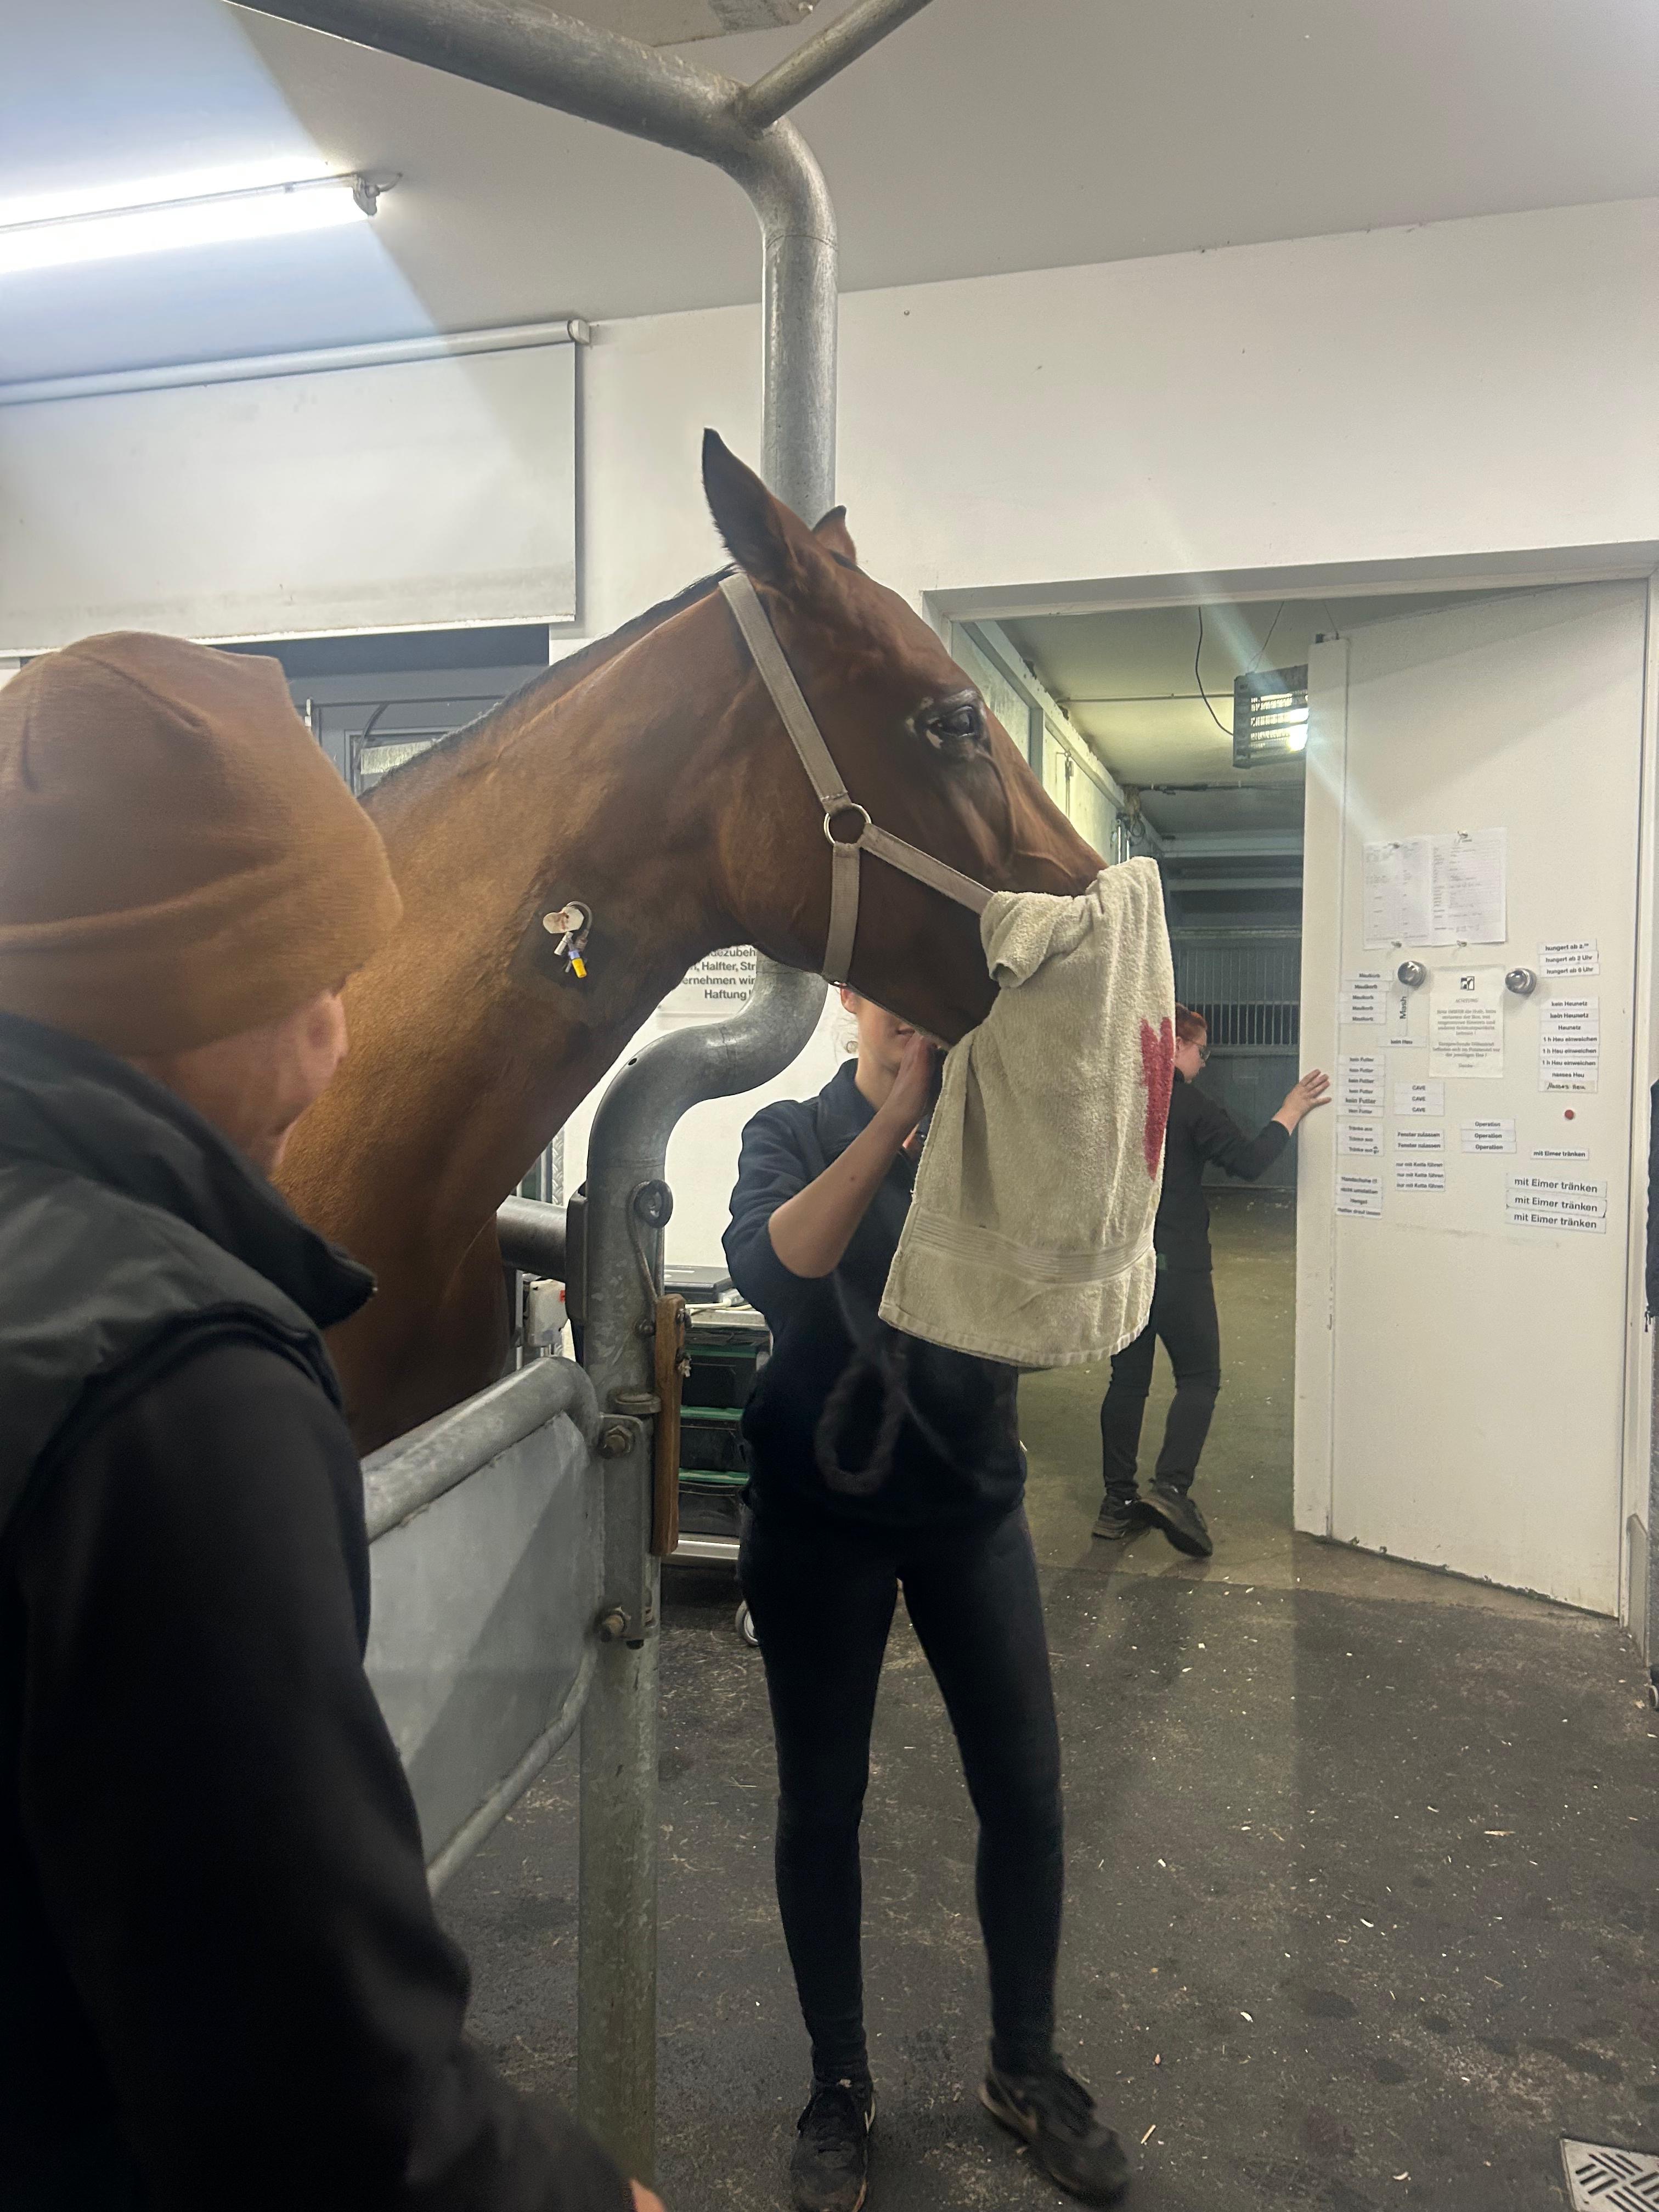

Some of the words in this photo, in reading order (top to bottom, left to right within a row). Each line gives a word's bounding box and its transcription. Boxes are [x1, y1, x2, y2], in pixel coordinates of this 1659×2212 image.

[702, 961, 738, 972] Halfter,
[739, 975, 755, 985] wir
[704, 989, 747, 1001] Haftung
[1514, 1177, 1529, 1187] mit
[1531, 1178, 1559, 1189] Eimer
[1561, 1181, 1598, 1193] tränken
[1515, 1195, 1530, 1205] mit
[1532, 1197, 1559, 1207] Eimer
[1561, 1200, 1598, 1212] tränken
[1514, 1212, 1529, 1222] mit
[1531, 1214, 1558, 1224] Eimer
[1560, 1217, 1597, 1229] tränken
